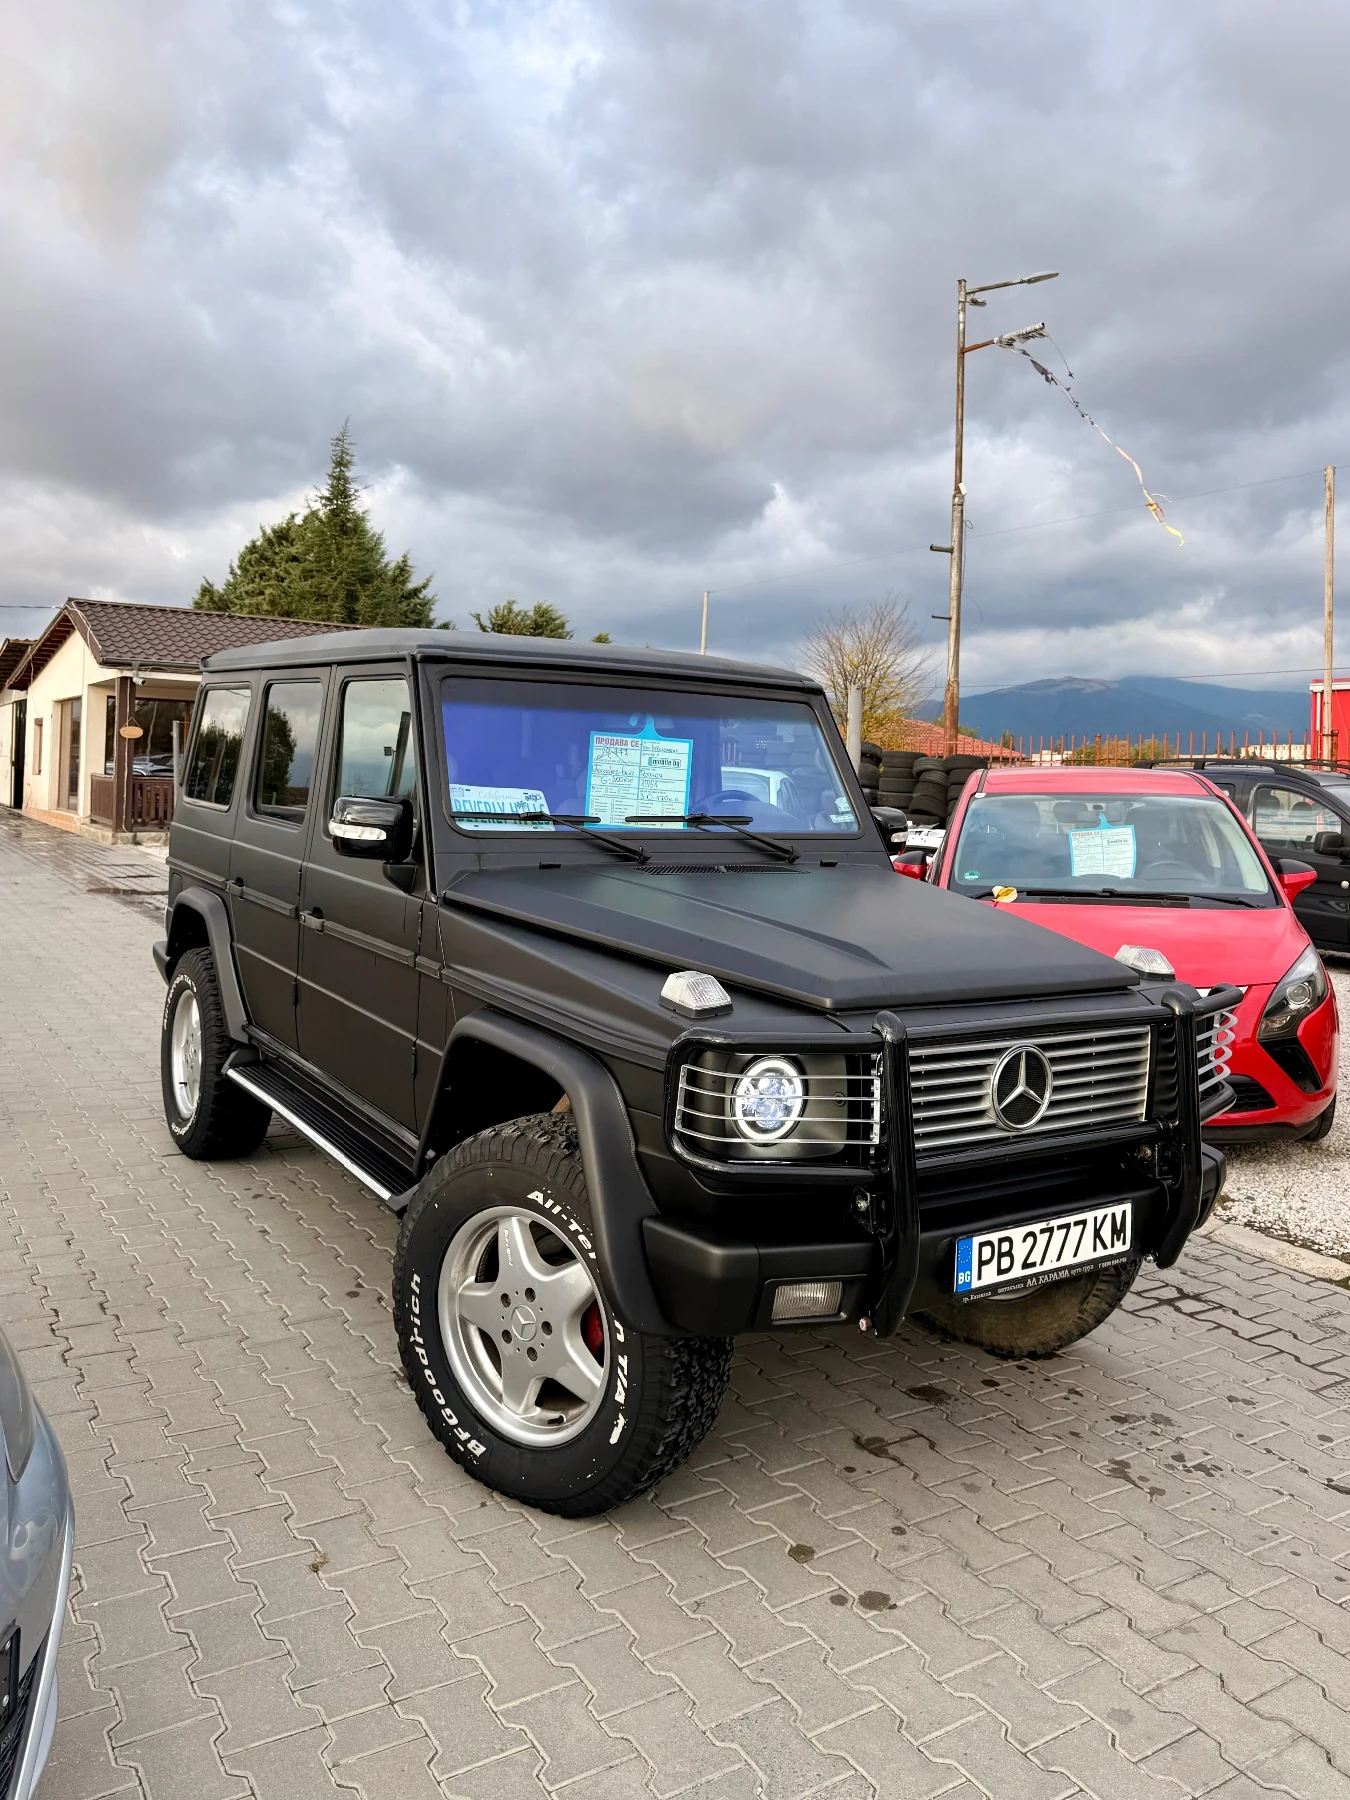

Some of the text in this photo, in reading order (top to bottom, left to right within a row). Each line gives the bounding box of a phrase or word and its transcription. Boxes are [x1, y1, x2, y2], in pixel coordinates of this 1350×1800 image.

[595, 736, 629, 747] ПРОДАВА
[630, 740, 640, 748] СЕ
[478, 789, 521, 801] California
[976, 1209, 1127, 1281] PB 2777 KM
[957, 1271, 972, 1285] BG
[409, 1273, 487, 1458] BFGoodrich
